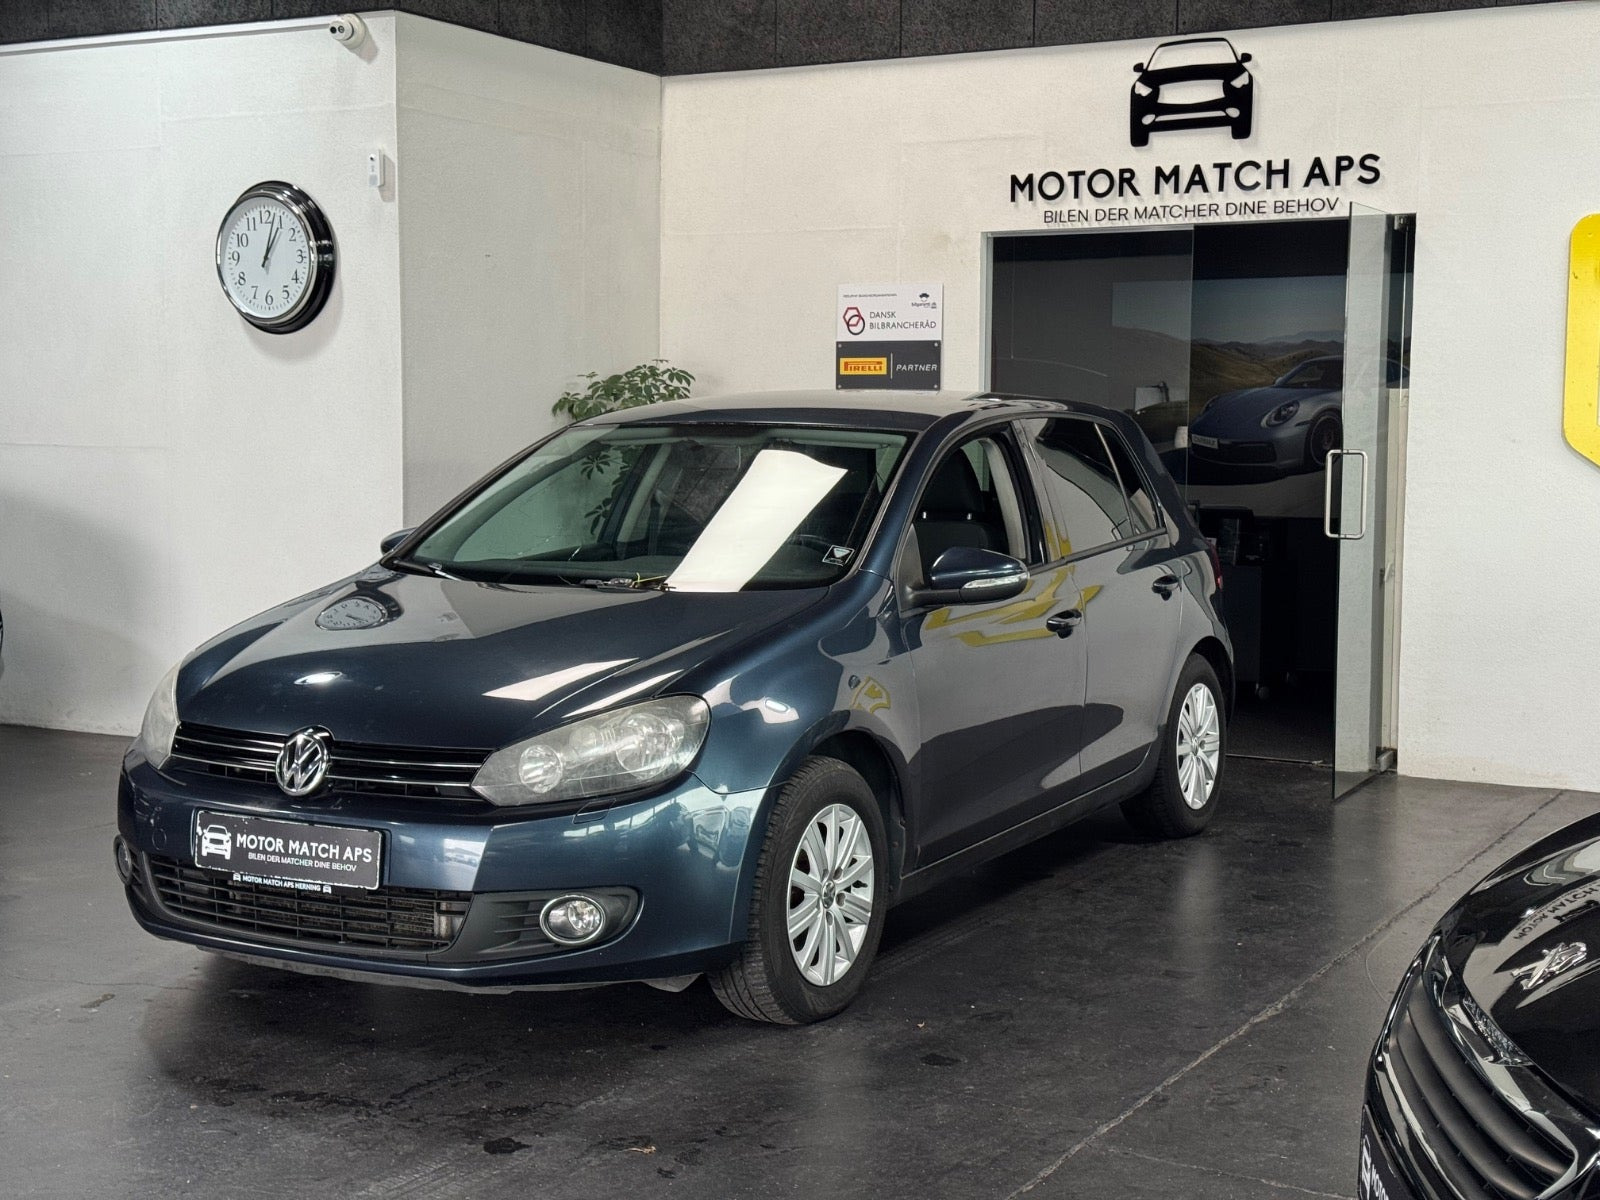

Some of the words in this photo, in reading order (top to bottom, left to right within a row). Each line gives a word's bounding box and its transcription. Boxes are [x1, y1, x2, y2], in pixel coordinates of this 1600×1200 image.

[1010, 168, 1140, 202] MOTOR
[1154, 158, 1289, 195] MATCH
[1303, 153, 1380, 188] APS
[259, 209, 272, 225] 12
[1043, 209, 1088, 224] BILEN
[1094, 207, 1128, 222] DER
[1134, 203, 1219, 220] MATCHER
[1226, 201, 1266, 216] DINE
[1273, 197, 1339, 214] BEHOV
[246, 216, 257, 231] 11
[236, 232, 249, 247] 10
[288, 227, 297, 242] 2
[231, 251, 240, 266] 9
[296, 249, 304, 264] 3
[238, 271, 246, 286] 8
[291, 269, 300, 284] 4
[250, 285, 258, 300] 7
[265, 289, 274, 305] 6
[282, 285, 290, 300] 5
[869, 311, 897, 319] DANSK
[869, 320, 937, 330] BILBRANCHERÅD
[843, 360, 883, 372] PIRELLI
[896, 364, 938, 372] PARTNER
[236, 833, 285, 854] MOTOR
[288, 839, 340, 860] MATCH
[343, 846, 373, 863] APS
[248, 851, 266, 861] BILEN
[266, 854, 281, 864] DER
[281, 857, 313, 867] MATCHER
[314, 860, 330, 869] DINE
[332, 863, 357, 872] BEHOV
[242, 875, 263, 885] MOTOR
[263, 878, 283, 888] MATCH
[283, 881, 295, 889] APS
[295, 882, 322, 892] HERNING
